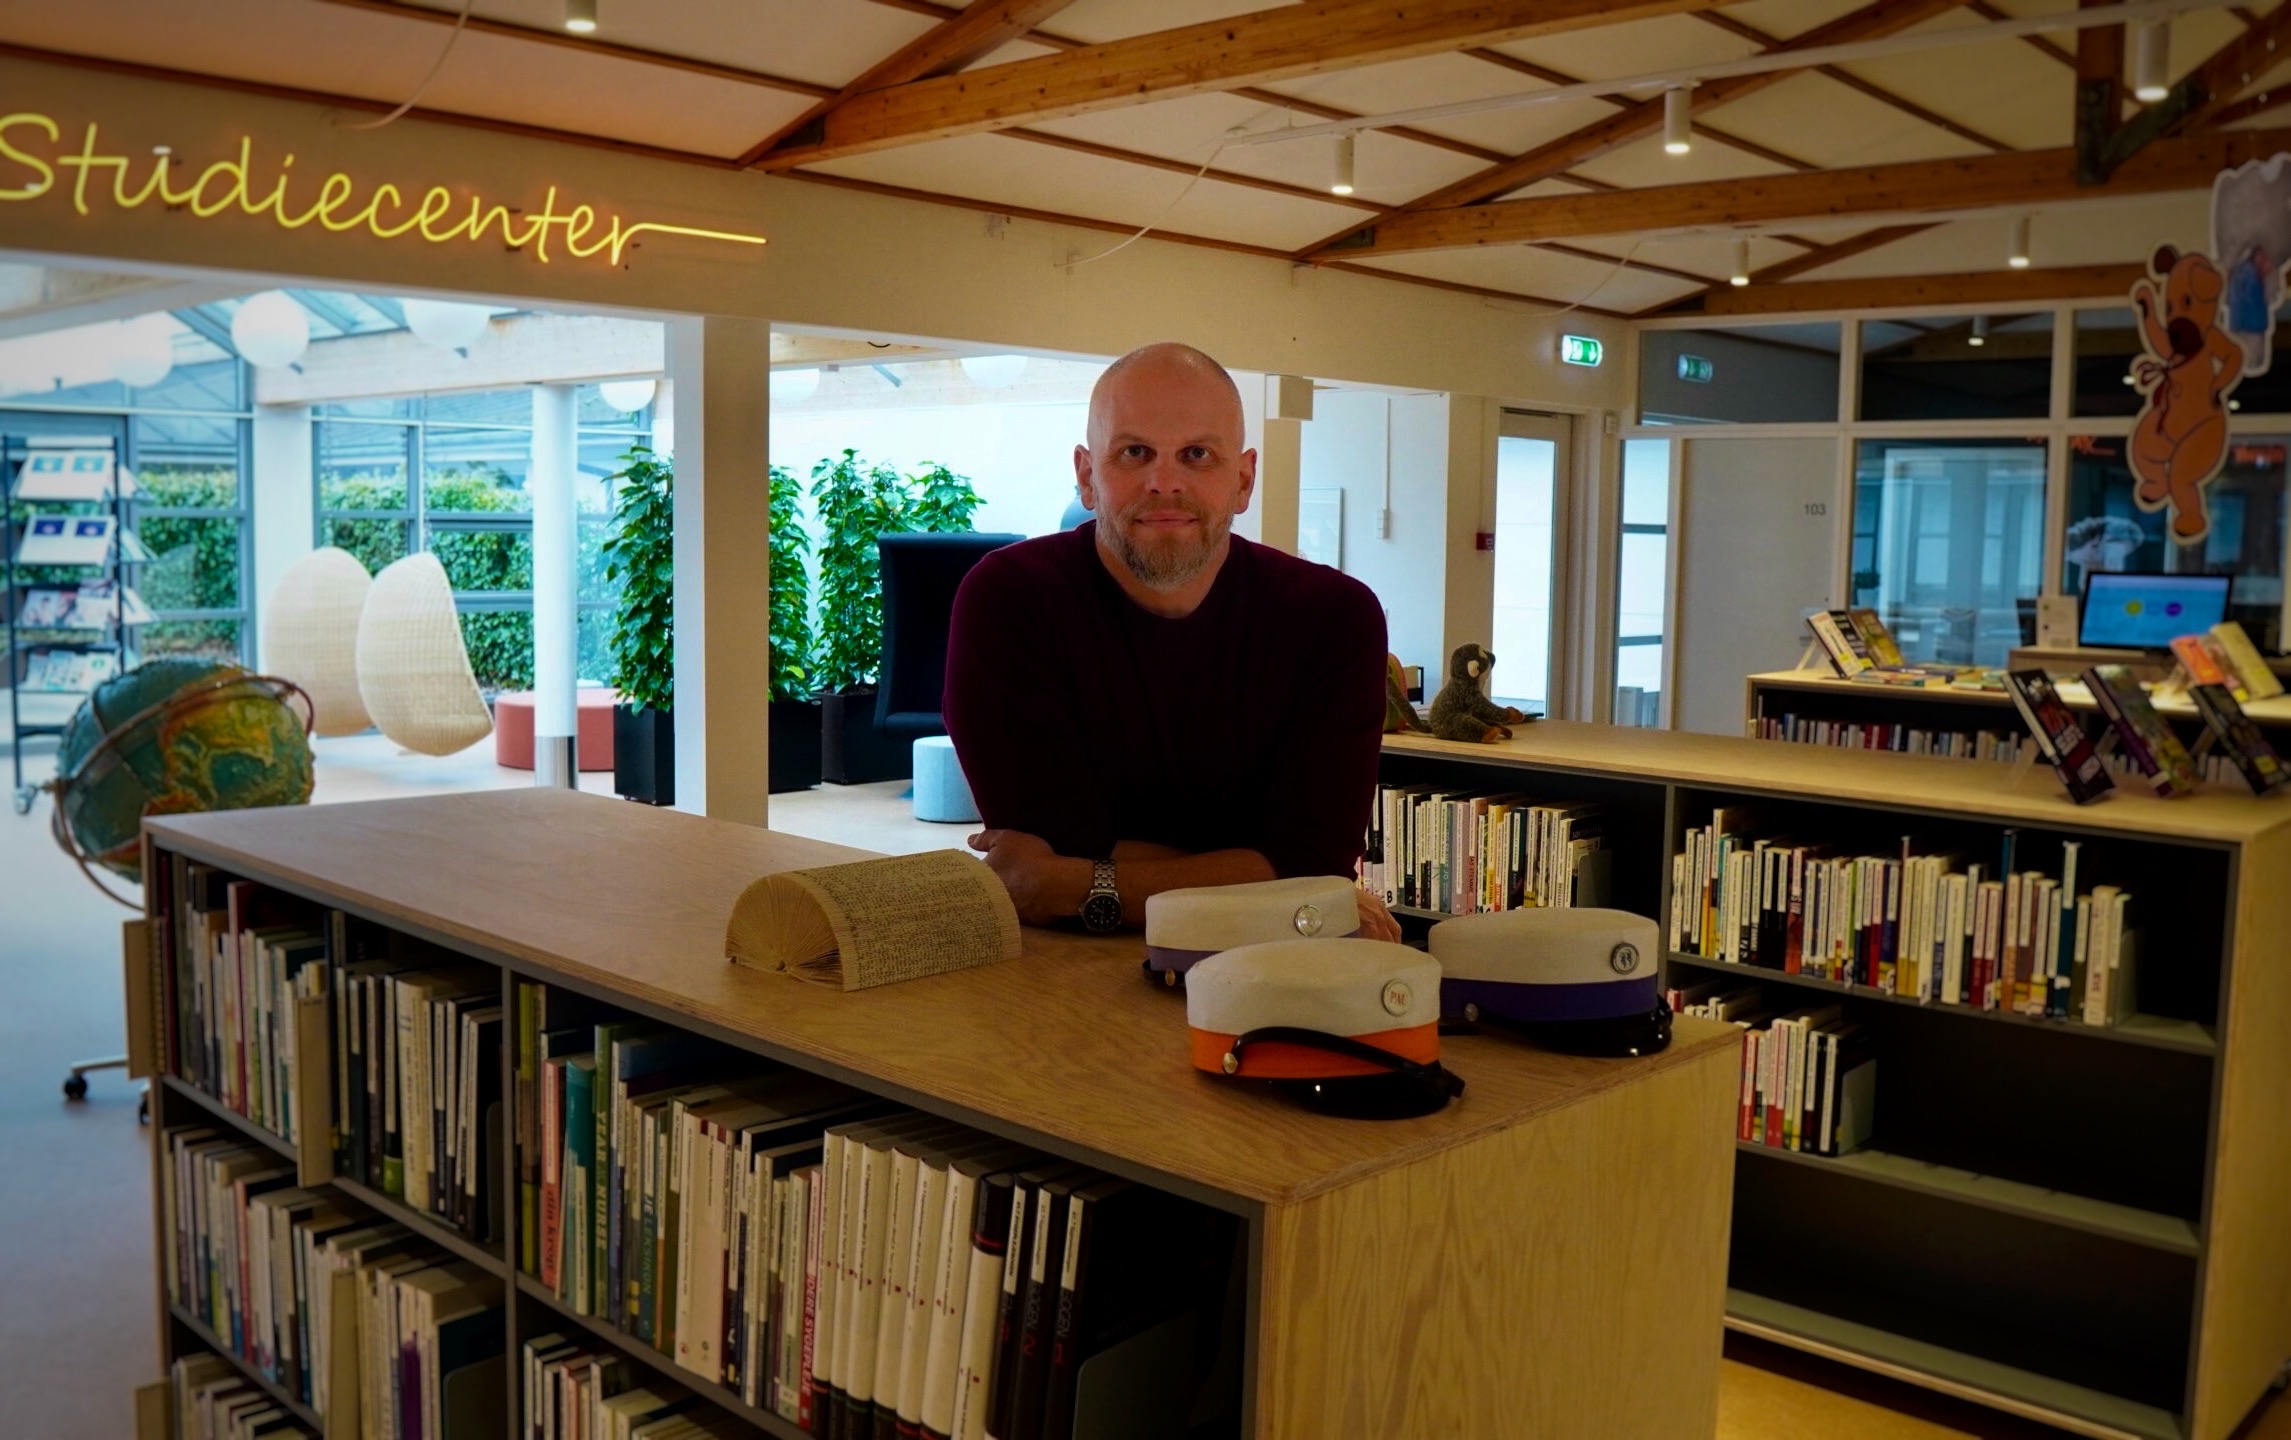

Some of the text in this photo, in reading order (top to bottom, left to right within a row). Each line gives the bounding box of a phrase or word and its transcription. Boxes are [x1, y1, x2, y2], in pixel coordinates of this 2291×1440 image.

[0, 112, 766, 267] Studiecenter
[1804, 503, 1827, 516] 103
[596, 1111, 607, 1162] YEAR
[547, 1190, 557, 1221] din
[596, 1184, 607, 1250] NURSE
[642, 1216, 654, 1294] LEKSIKON
[800, 1316, 816, 1396] SYGEPLEJE
